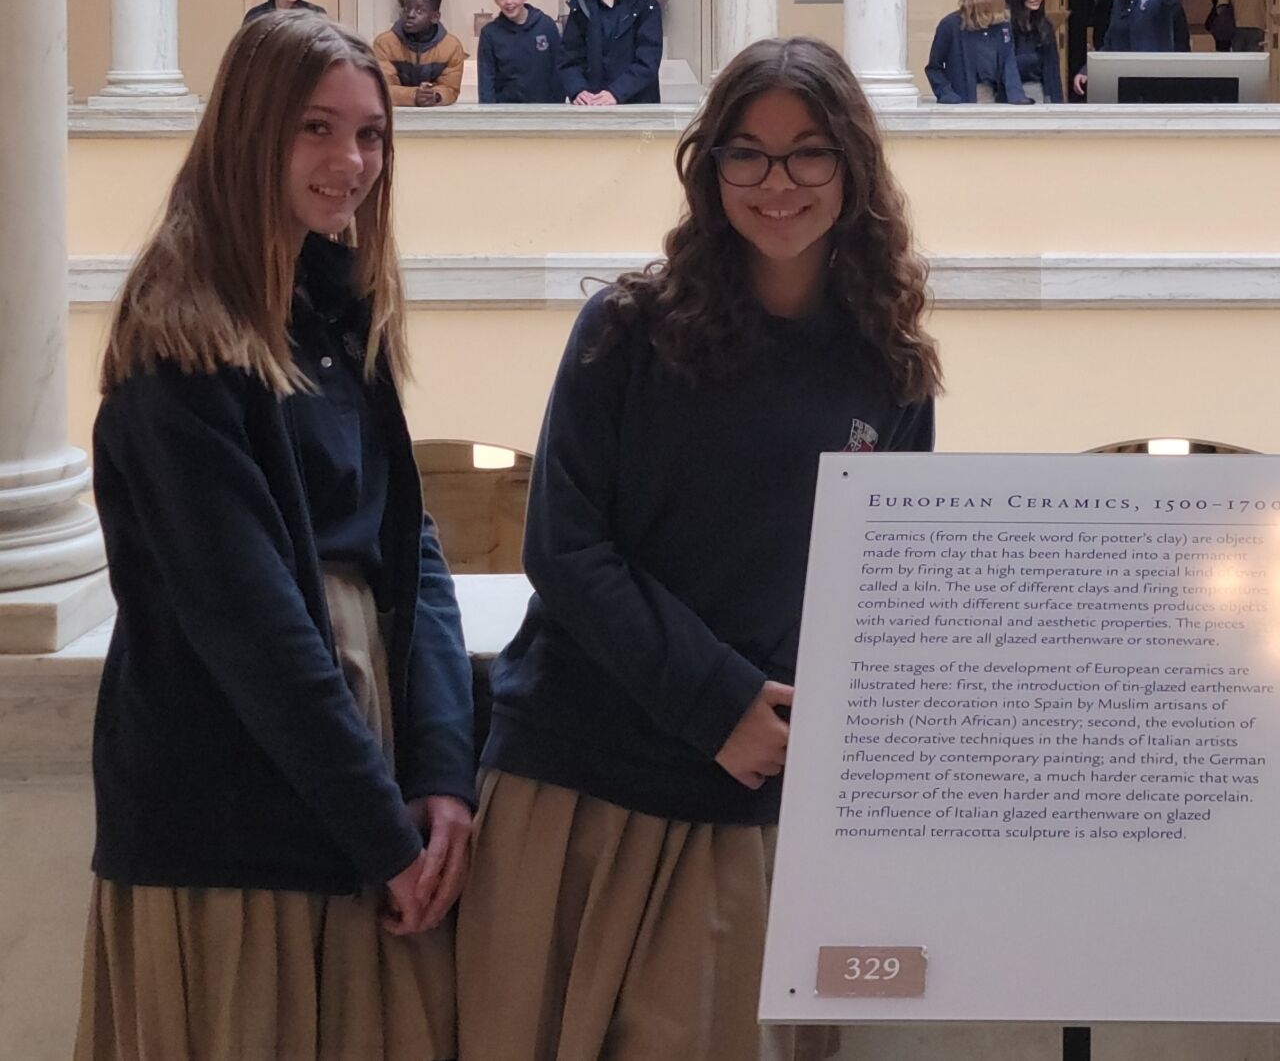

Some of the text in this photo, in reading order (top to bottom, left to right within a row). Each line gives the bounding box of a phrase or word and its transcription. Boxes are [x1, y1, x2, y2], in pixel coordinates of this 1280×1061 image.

[867, 494, 994, 508] EUROPEAN
[1007, 494, 1141, 512] CERAMICS,
[864, 530, 925, 541] Ceramics
[929, 530, 967, 543] (from
[972, 530, 993, 541] the
[996, 531, 1035, 542] Greek
[1039, 531, 1073, 542] word
[1078, 531, 1098, 542] for
[1101, 532, 1152, 546] potter’s
[1156, 532, 1187, 546] clay)
[857, 596, 925, 609] combined
[928, 597, 958, 608] with
[962, 597, 1020, 609] different
[1023, 598, 1072, 609] surface
[1076, 600, 1149, 610] treatments
[1153, 599, 1215, 614] produces
[855, 614, 1245, 632] with varied functional and aesthetic properties. The pieces
[853, 631, 1219, 647] displayed here are all glazed earthenware or stoneware.
[849, 660, 1249, 677] Three stages of the development of European ceramics are
[849, 677, 1273, 695] illustrated here: first, the introduction of tin-glazed earthenware
[847, 695, 1228, 712] with luster decoration into Spain by Muslim artisans of
[846, 713, 1256, 730] Moorish (North African) ancestry; second, the evolution of
[843, 732, 1238, 748] these decorative techniques in the hands of Italian artists
[842, 749, 1265, 767] influenced by contemporary painting; and third, the German
[839, 768, 1259, 784] development of stoneware, a much harder ceramic that was
[838, 787, 1252, 805] a precursor of the even harder and more delicate porcelain.
[834, 805, 1210, 824] The influence of Italian glazed earthenware on glazed
[834, 823, 1186, 842] monumental terracotta sculpture is also explored.
[844, 957, 900, 980] 329
